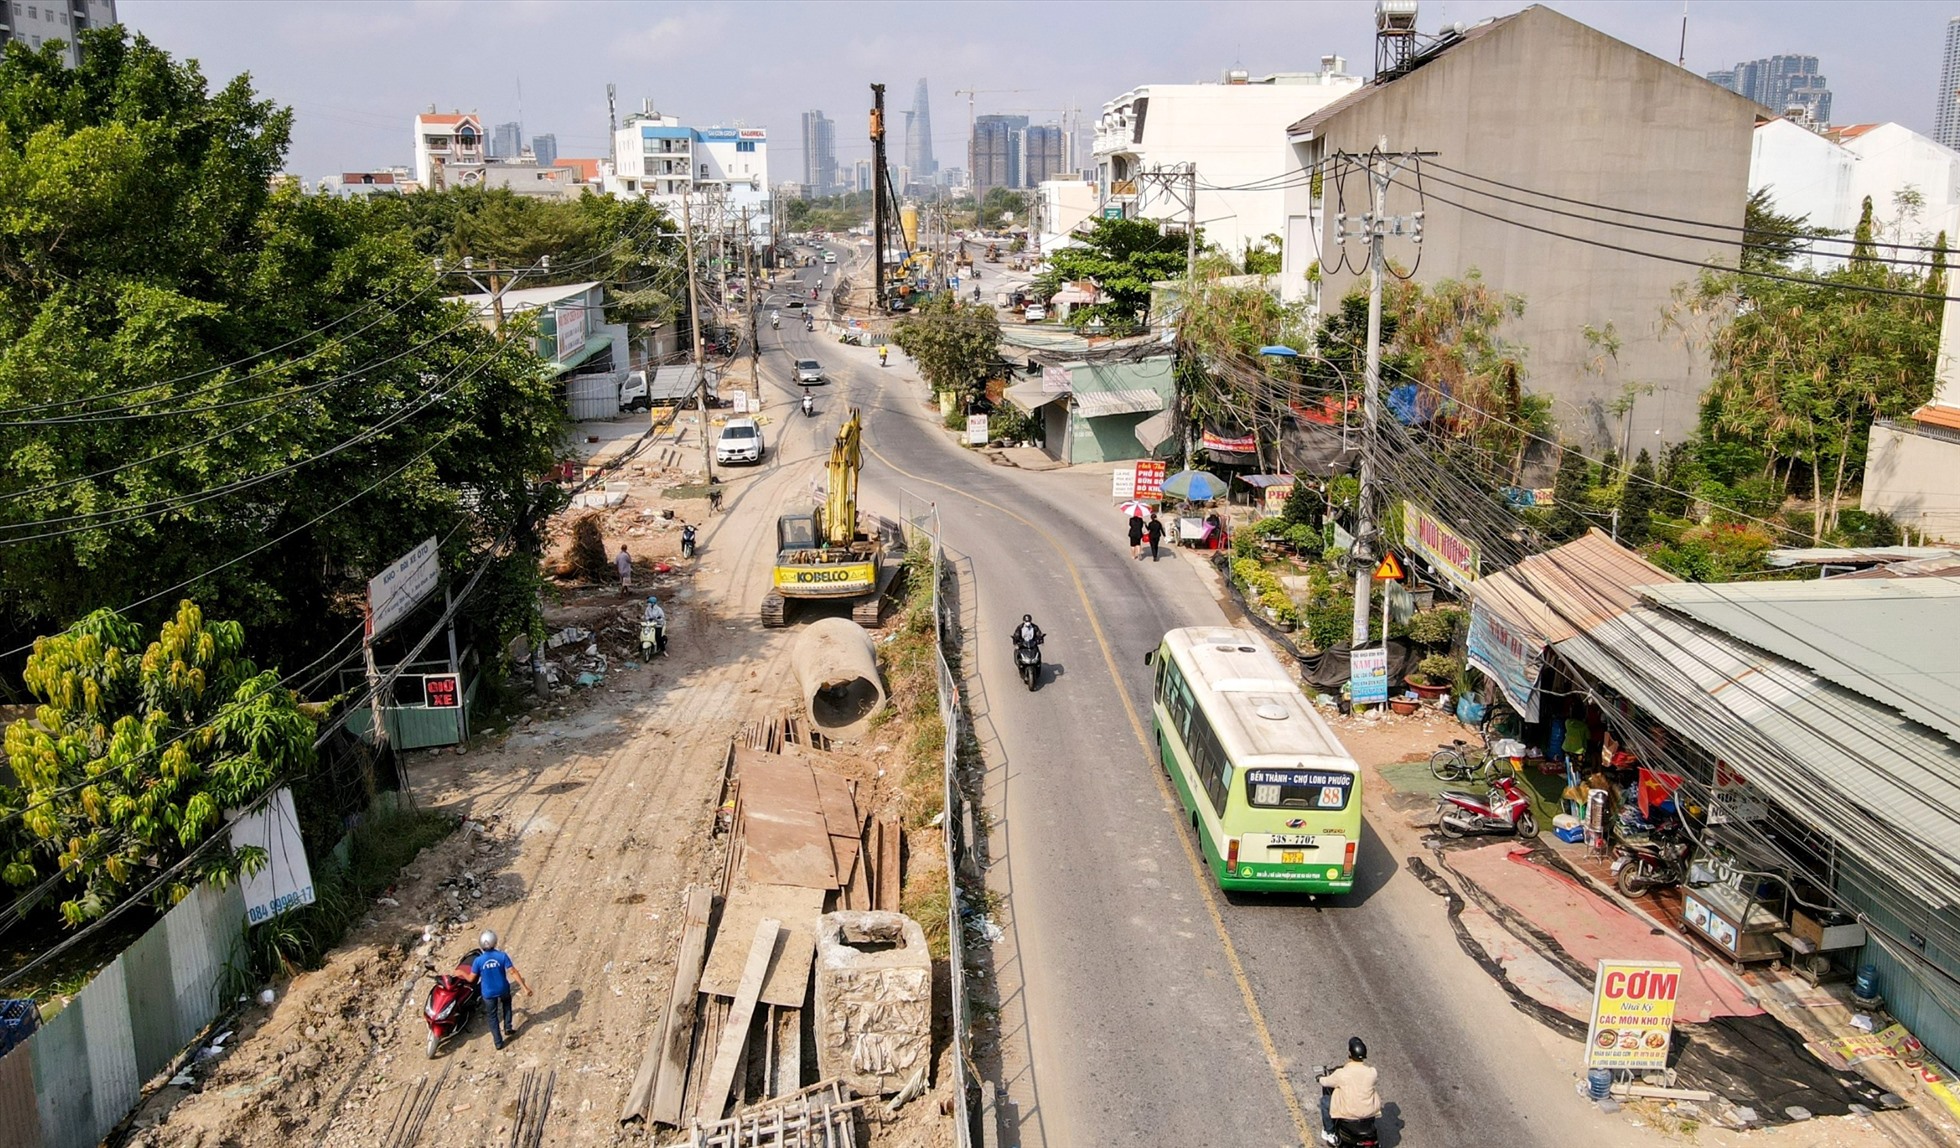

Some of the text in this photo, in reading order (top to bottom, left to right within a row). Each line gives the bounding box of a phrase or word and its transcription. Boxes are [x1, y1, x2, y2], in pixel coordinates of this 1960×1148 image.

[797, 570, 849, 583] KOBELCO
[428, 679, 455, 693] GIỮ
[433, 694, 453, 705] XE
[1250, 770, 1263, 782] BẾN
[1265, 772, 1288, 783] THÀNH
[1294, 774, 1308, 786] CHỢ
[1309, 776, 1326, 784] LONG
[1328, 774, 1351, 786] PHƯỚC
[1257, 786, 1340, 805] 88 88
[1271, 834, 1287, 844] 53S
[1295, 835, 1316, 844] 7707
[249, 904, 268, 922] 084
[301, 886, 312, 902] 17
[1605, 970, 1678, 1000] CƠM
[1600, 1015, 1617, 1024] CÁC
[1619, 1016, 1639, 1025] MÓN
[1641, 1017, 1658, 1025] KHO
